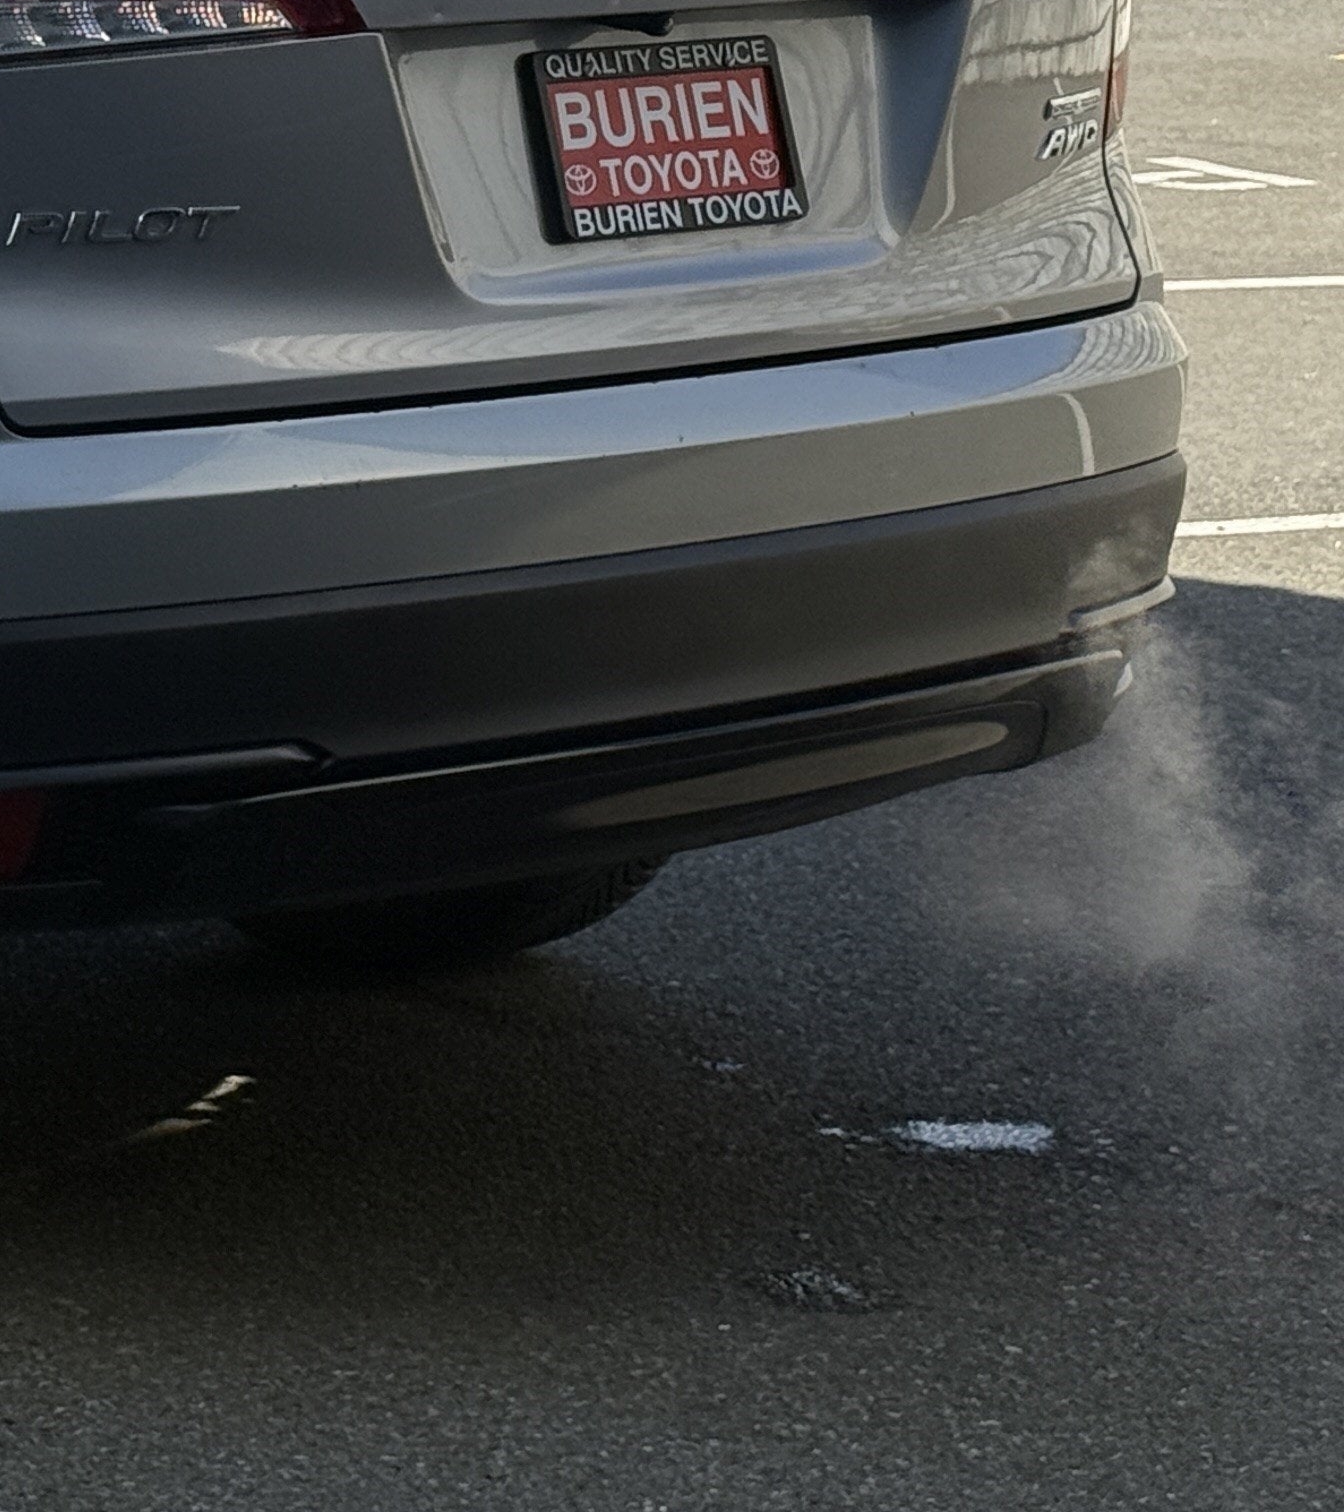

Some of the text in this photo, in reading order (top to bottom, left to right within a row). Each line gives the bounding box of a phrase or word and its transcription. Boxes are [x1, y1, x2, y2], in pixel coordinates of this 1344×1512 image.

[545, 39, 769, 79] QUALITY SERVICE
[554, 77, 770, 152] BURIEN
[1037, 119, 1099, 160] AWD
[599, 148, 749, 198] TOYOTA
[6, 205, 241, 247] PILOT
[573, 188, 803, 238] BURIEN TOYOTA
